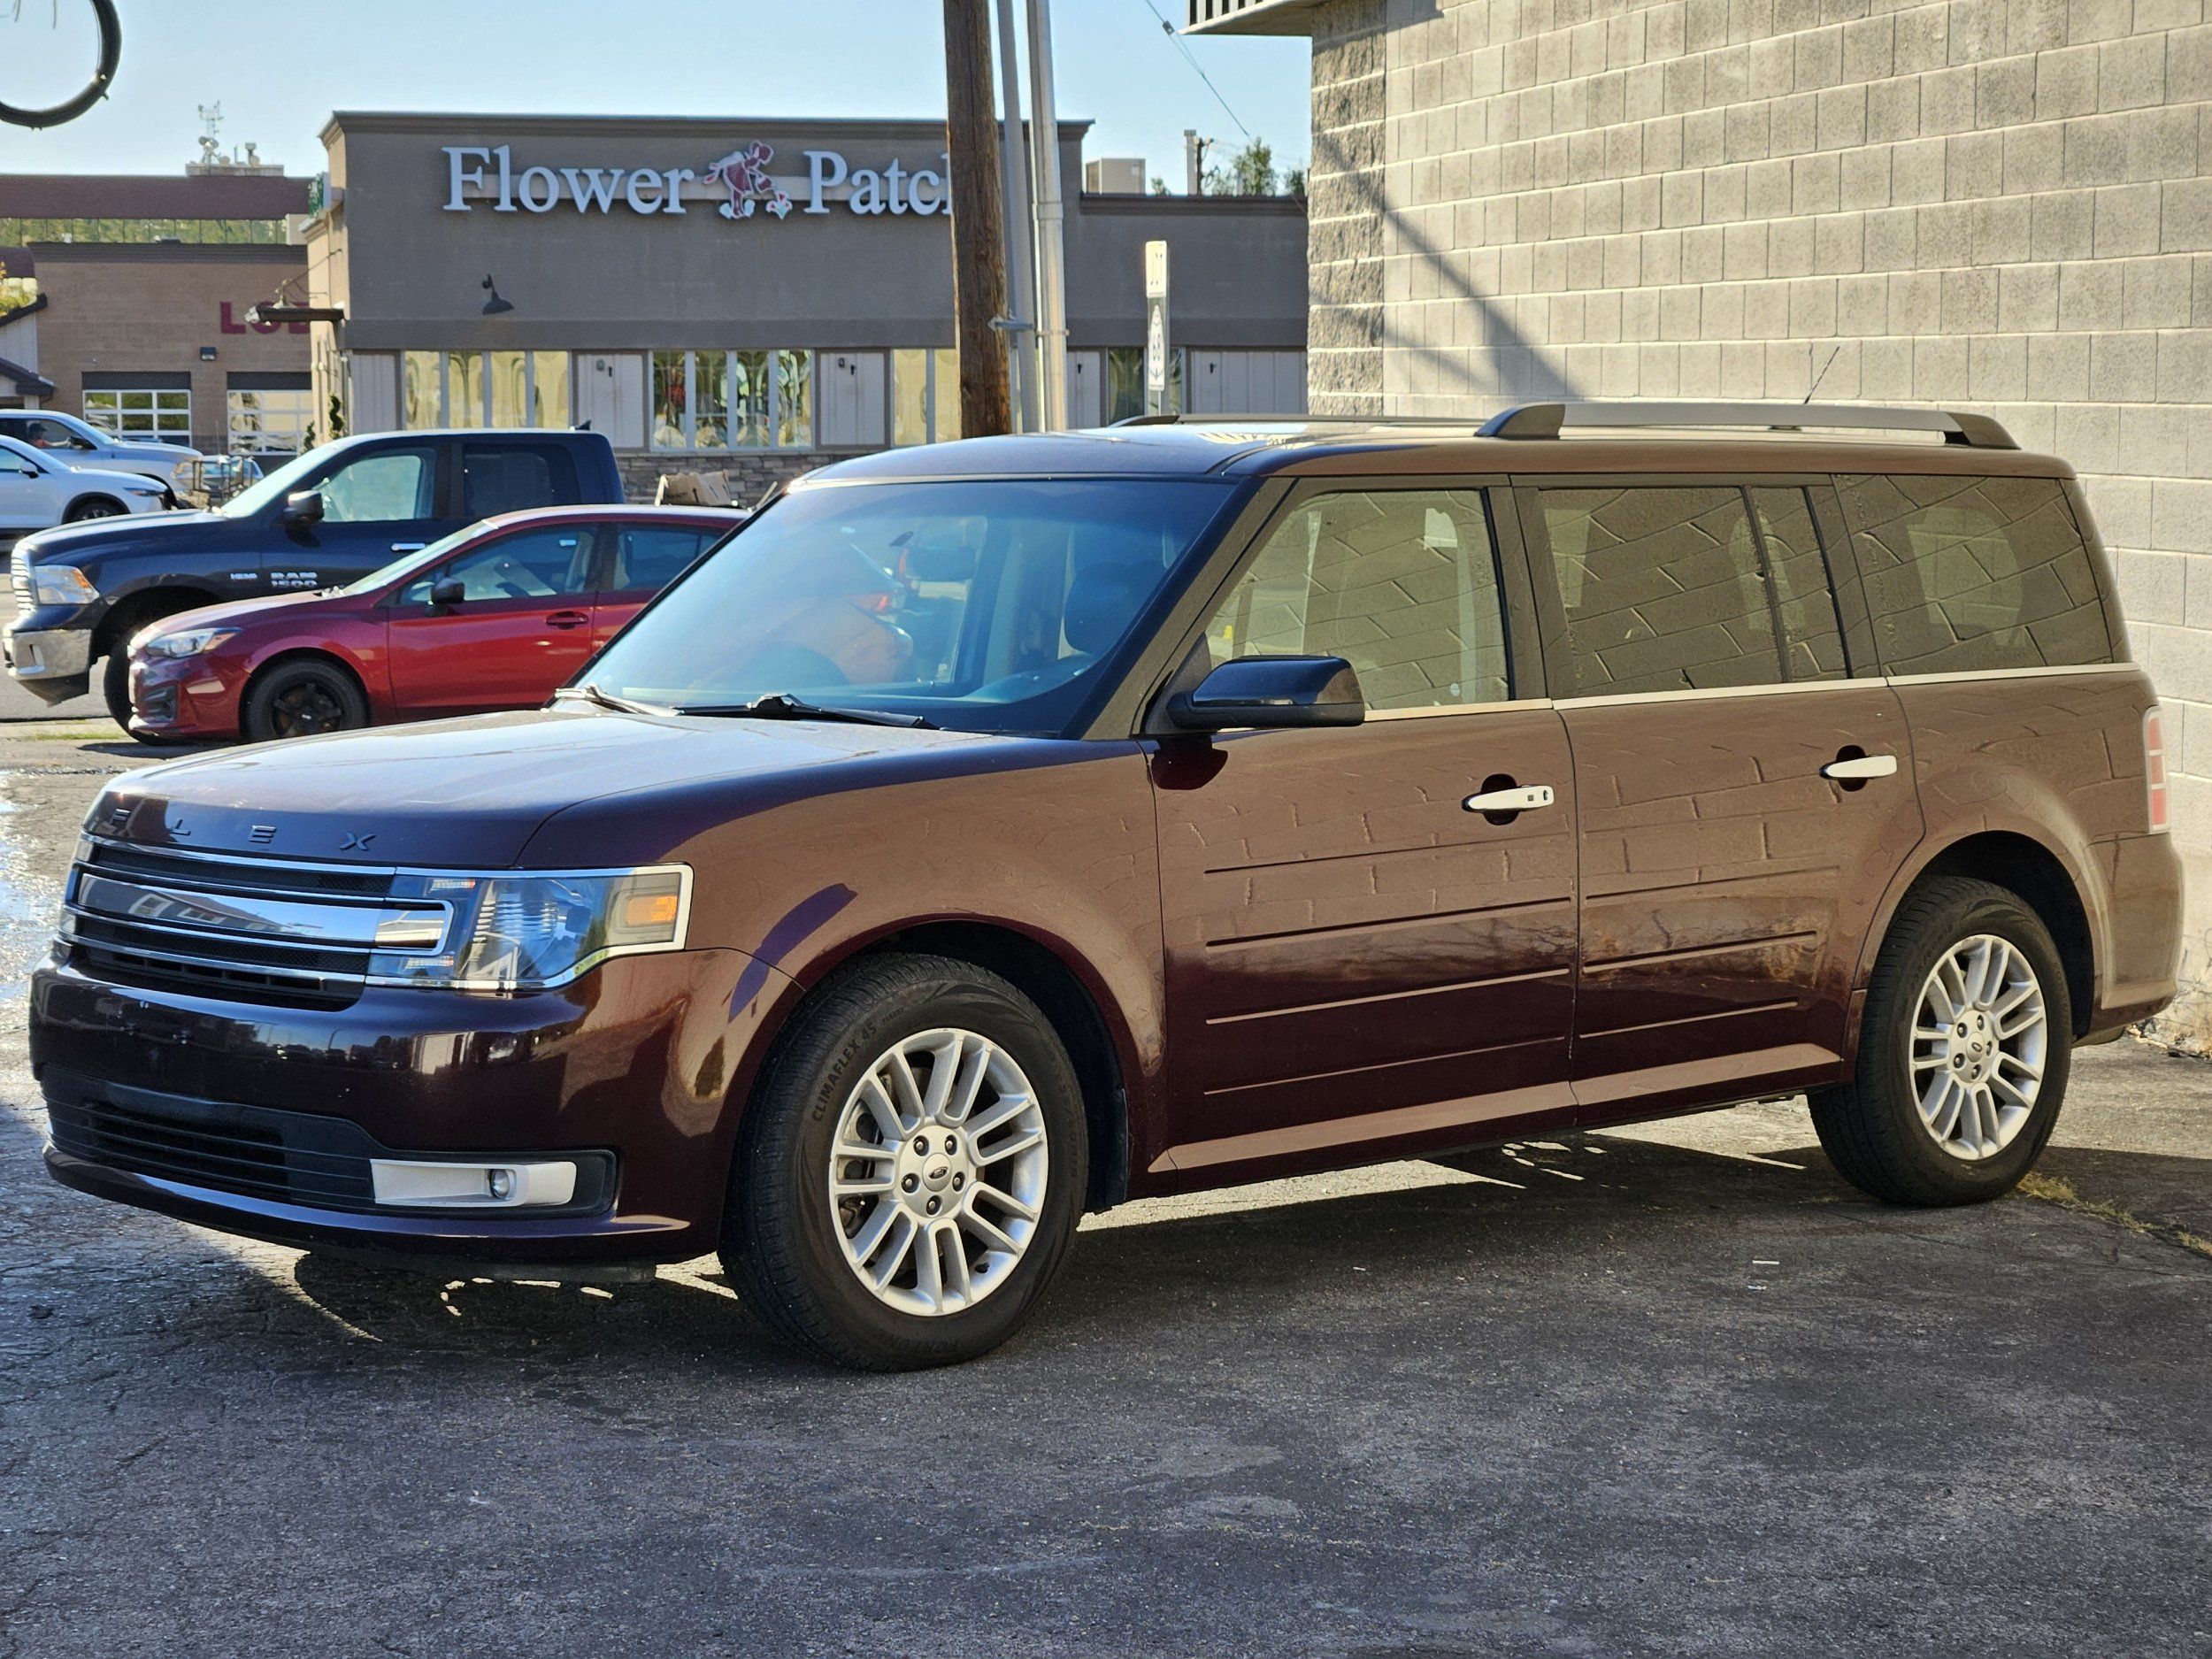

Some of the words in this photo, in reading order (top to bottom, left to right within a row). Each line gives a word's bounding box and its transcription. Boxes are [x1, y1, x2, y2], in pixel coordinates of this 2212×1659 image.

[442, 145, 694, 214] Flower
[803, 150, 953, 215] Patc
[111, 809, 376, 851] FLEX
[811, 1039, 860, 1121] CLIMAFLEX
